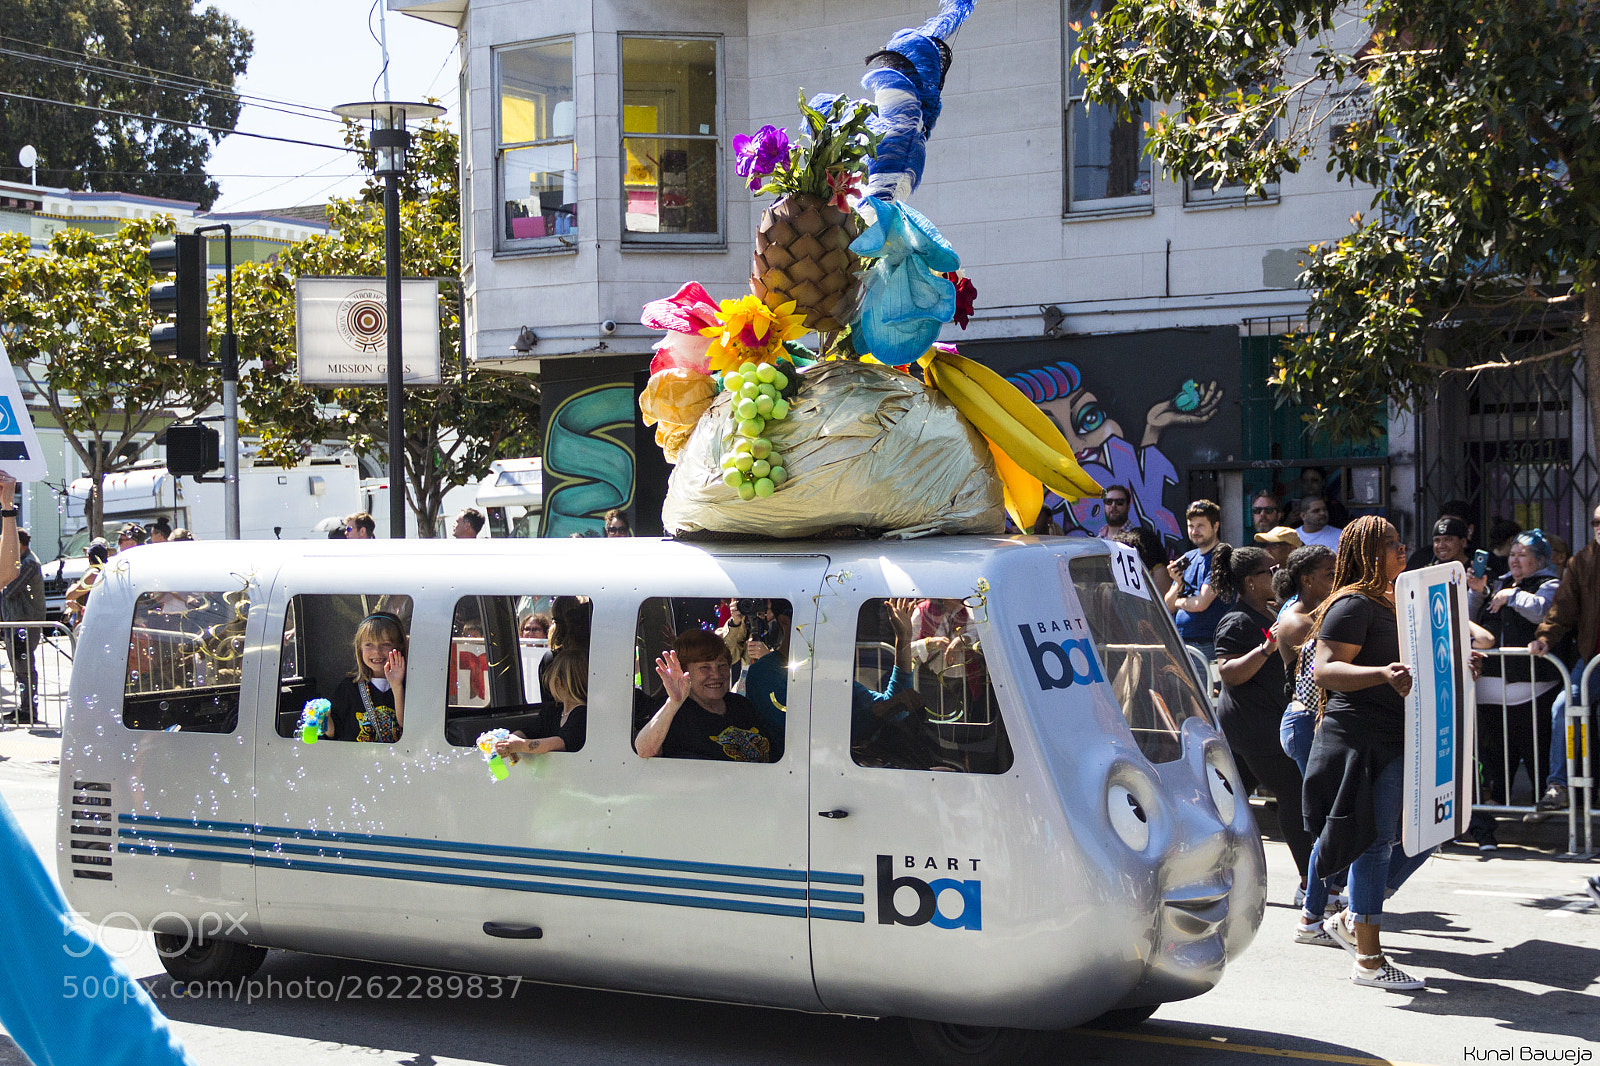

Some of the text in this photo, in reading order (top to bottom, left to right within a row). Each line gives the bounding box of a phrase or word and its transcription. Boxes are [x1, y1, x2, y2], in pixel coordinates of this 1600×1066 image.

[328, 364, 373, 374] MISSION
[1117, 551, 1141, 590] 15
[1037, 618, 1083, 633] BART
[1439, 791, 1453, 801] BART
[904, 855, 981, 872] BART
